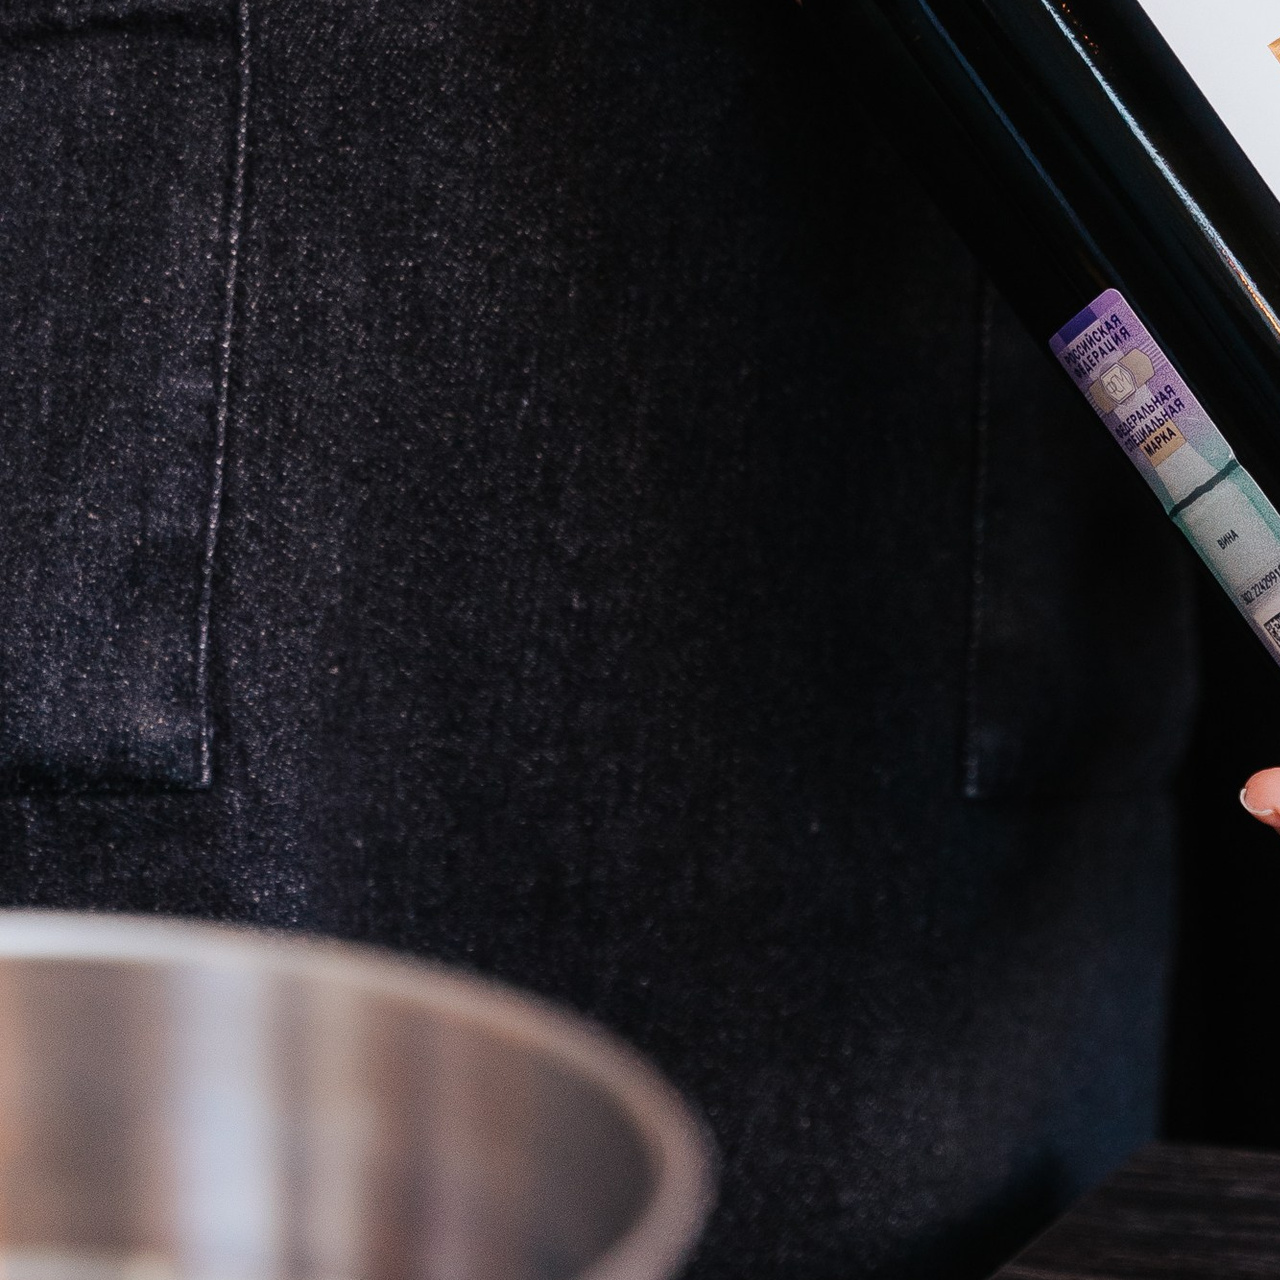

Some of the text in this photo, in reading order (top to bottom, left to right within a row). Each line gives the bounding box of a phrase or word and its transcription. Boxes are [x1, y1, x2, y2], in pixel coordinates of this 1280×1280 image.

[1064, 313, 1122, 367] РОССИЙСКАЯ
[1073, 326, 1132, 380] ФЕДЕРАЦИЯ
[1115, 384, 1177, 440] ФЕДЕРАЛЬНАЯ
[1124, 397, 1186, 453] СПЕЦИАЛЬНАЯ
[1143, 426, 1177, 457] МАРКА
[1217, 529, 1239, 550] ВИНА
